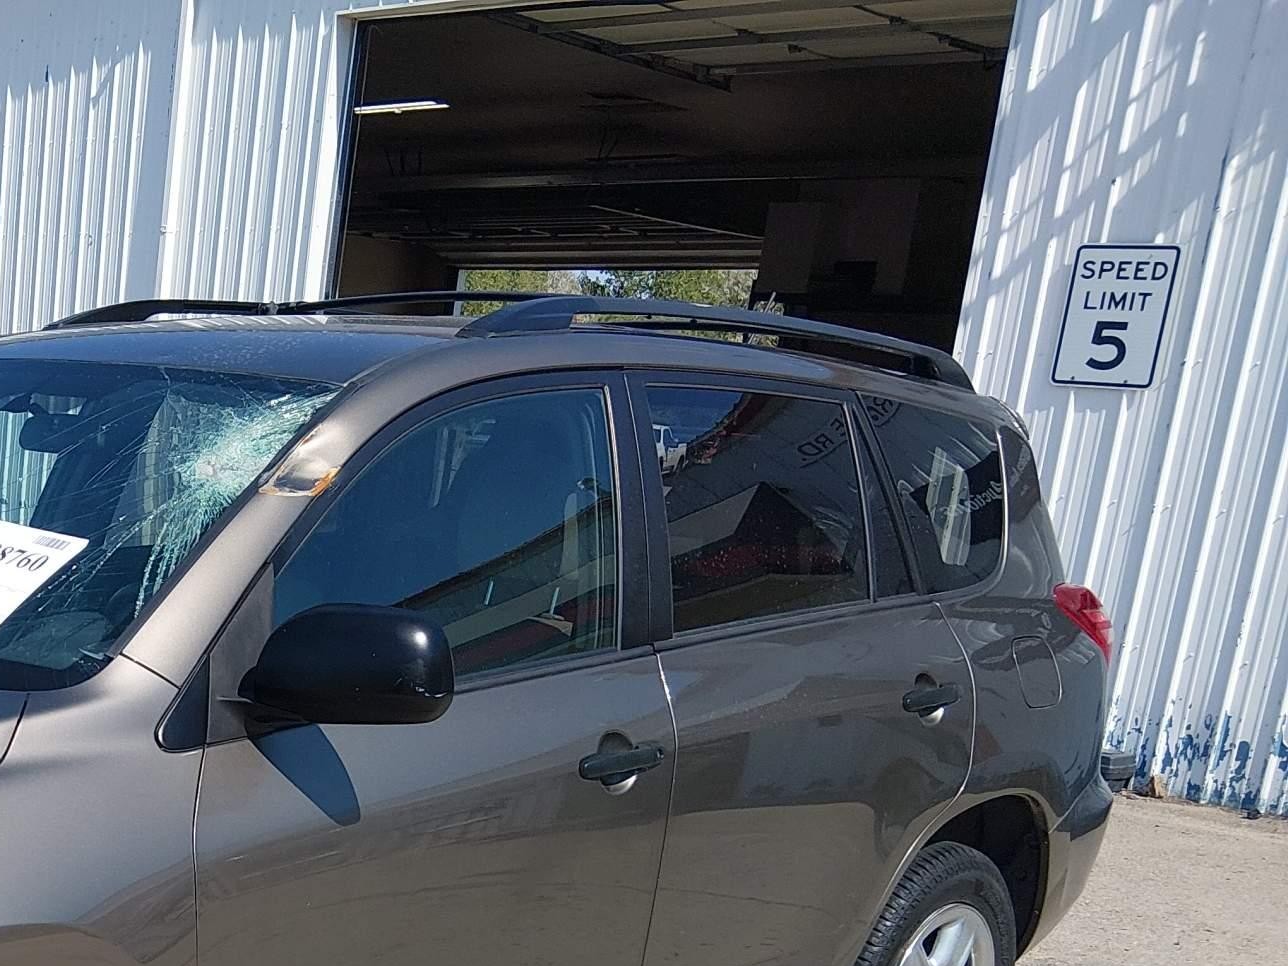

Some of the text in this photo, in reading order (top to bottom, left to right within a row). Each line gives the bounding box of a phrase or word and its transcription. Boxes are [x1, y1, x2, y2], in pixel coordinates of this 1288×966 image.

[1080, 260, 1169, 281] SPEED
[1083, 291, 1153, 311] LIMIT
[1085, 320, 1129, 371] 5
